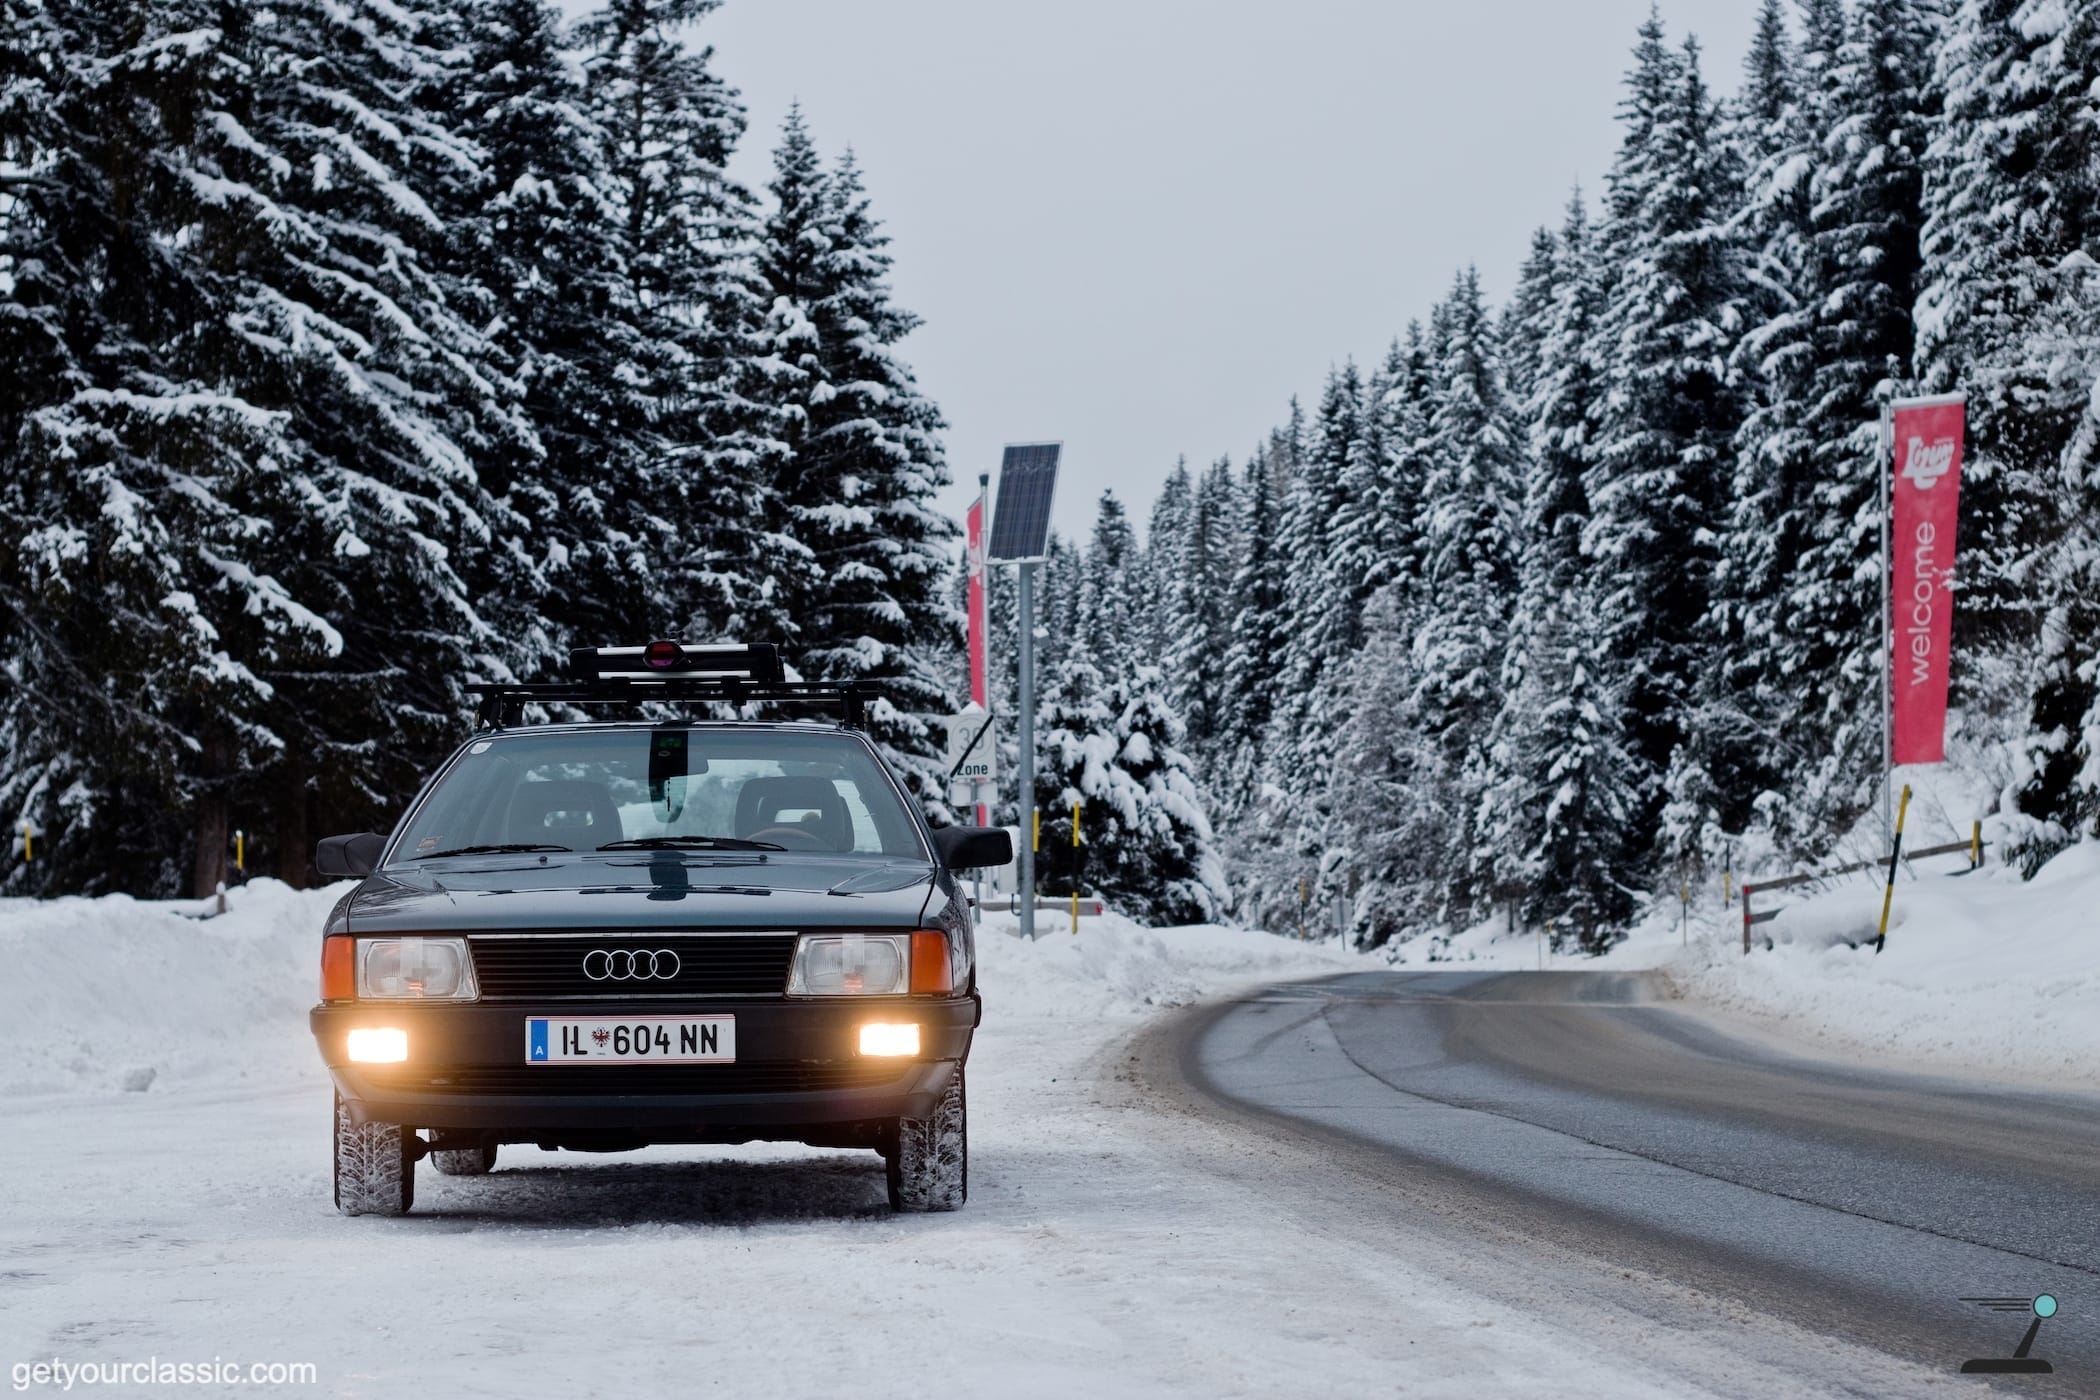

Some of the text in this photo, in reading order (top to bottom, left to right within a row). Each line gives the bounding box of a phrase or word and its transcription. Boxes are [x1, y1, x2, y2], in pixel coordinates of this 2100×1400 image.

[1908, 521, 1936, 686] welcome
[535, 1046, 544, 1056] A
[562, 1024, 718, 1055] IL 604 NN
